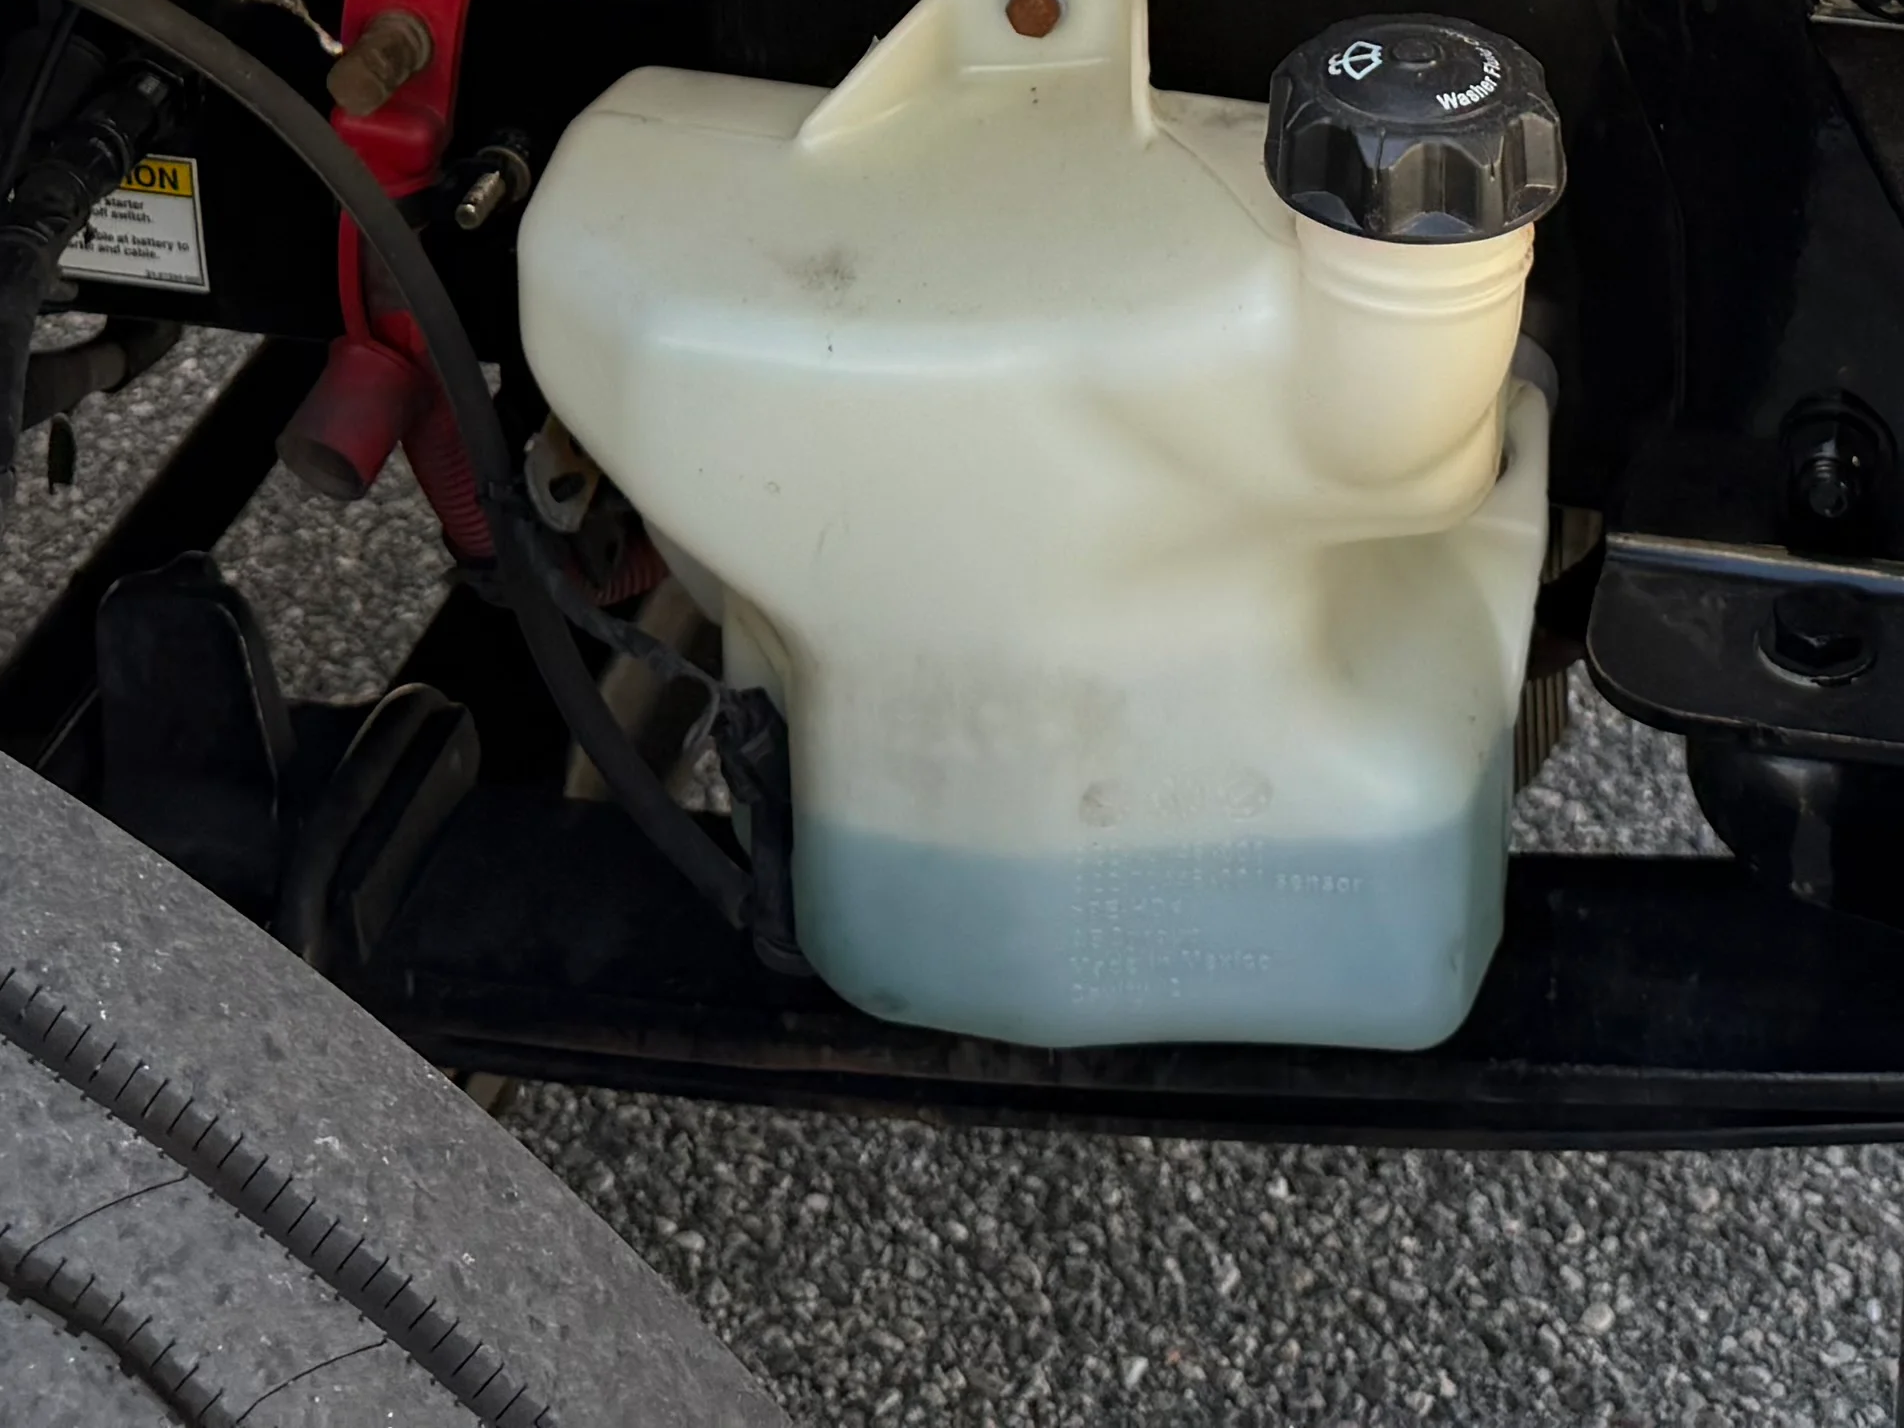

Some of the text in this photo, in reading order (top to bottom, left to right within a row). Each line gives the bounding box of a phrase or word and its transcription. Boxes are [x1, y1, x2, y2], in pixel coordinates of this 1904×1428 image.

[1436, 75, 1497, 110] Washer
[98, 244, 121, 255] and
[131, 235, 173, 251] battery
[177, 241, 189, 251] to
